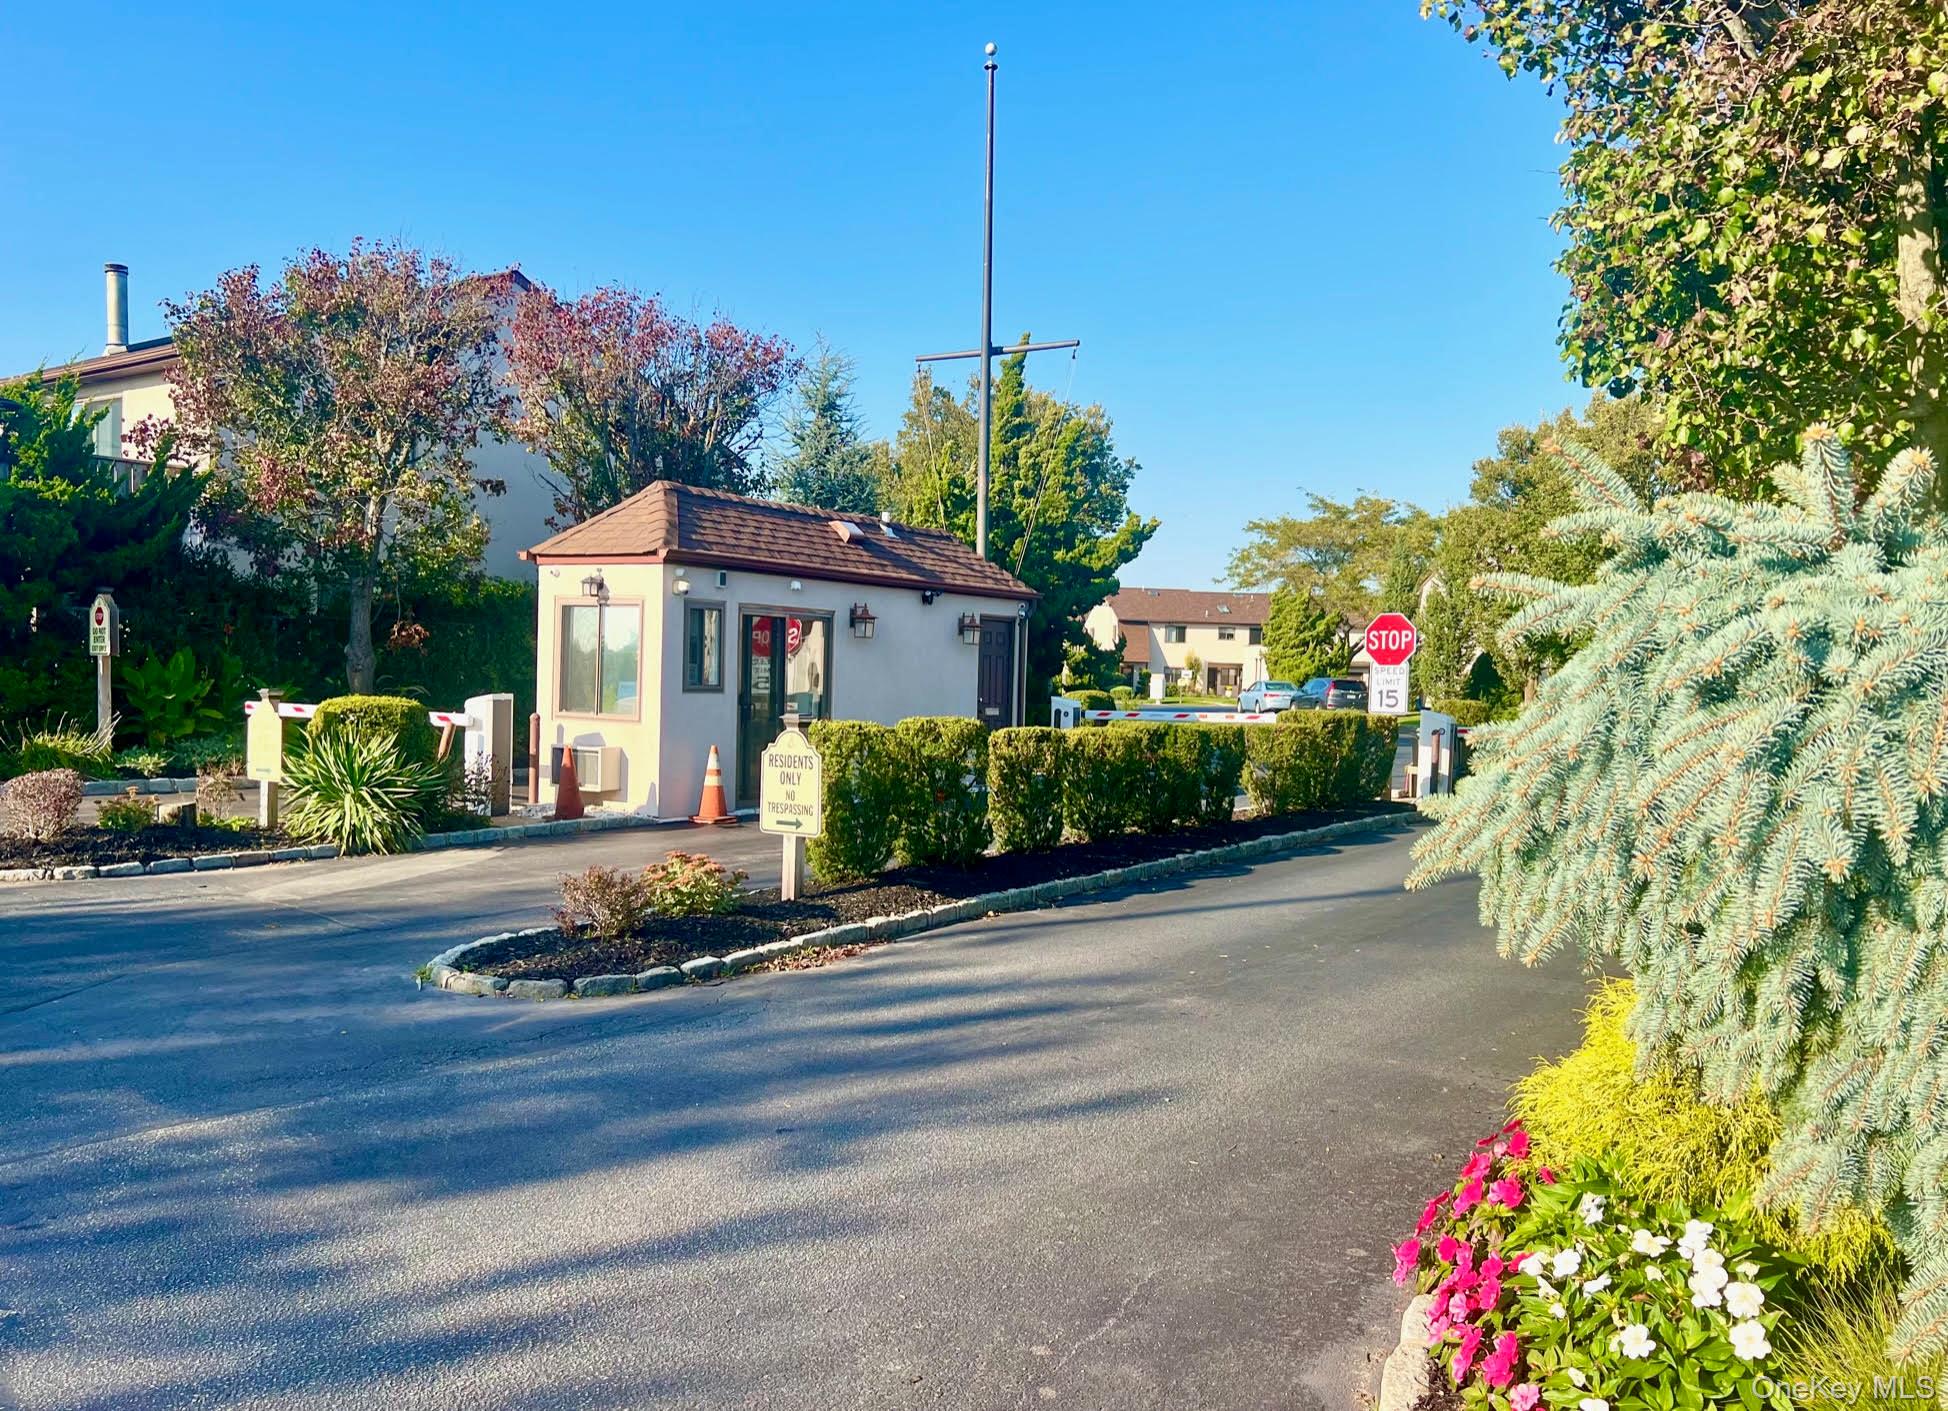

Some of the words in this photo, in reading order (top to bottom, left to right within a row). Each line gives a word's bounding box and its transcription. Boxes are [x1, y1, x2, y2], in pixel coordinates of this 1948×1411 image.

[93, 635, 105, 644] ENTER
[1368, 630, 1412, 650] STOP
[1375, 666, 1405, 675] SPEED
[1376, 678, 1401, 686] LIMIT
[1378, 689, 1399, 708] 15
[768, 753, 814, 770] RESIDENTS
[779, 771, 802, 786] ONLY
[785, 790, 796, 802] NO
[768, 801, 814, 817] TRESPASSING
